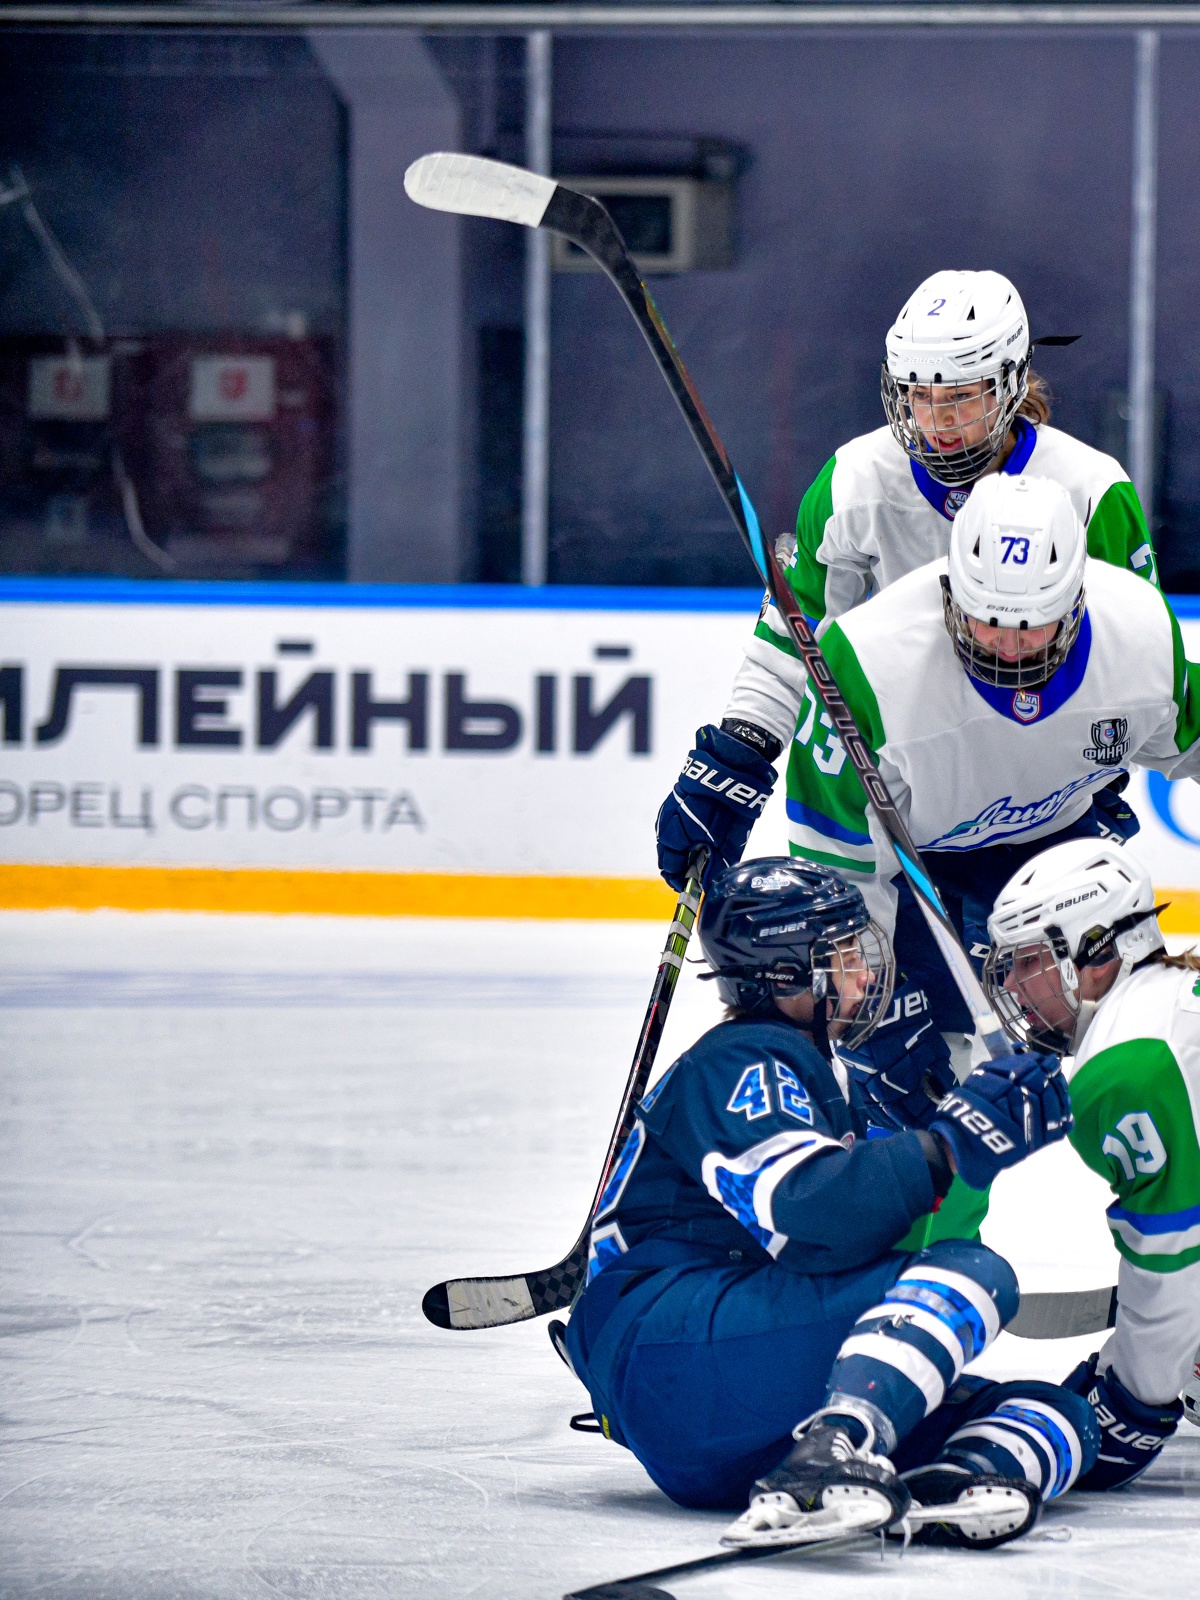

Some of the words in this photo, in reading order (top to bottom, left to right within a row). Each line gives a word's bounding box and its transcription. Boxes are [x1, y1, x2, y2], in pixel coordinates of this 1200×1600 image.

[927, 298, 947, 317] 2
[1000, 536, 1030, 566] 73
[169, 782, 427, 834] СПОРТА
[726, 1059, 815, 1127] 42
[1101, 1110, 1168, 1182] 19
